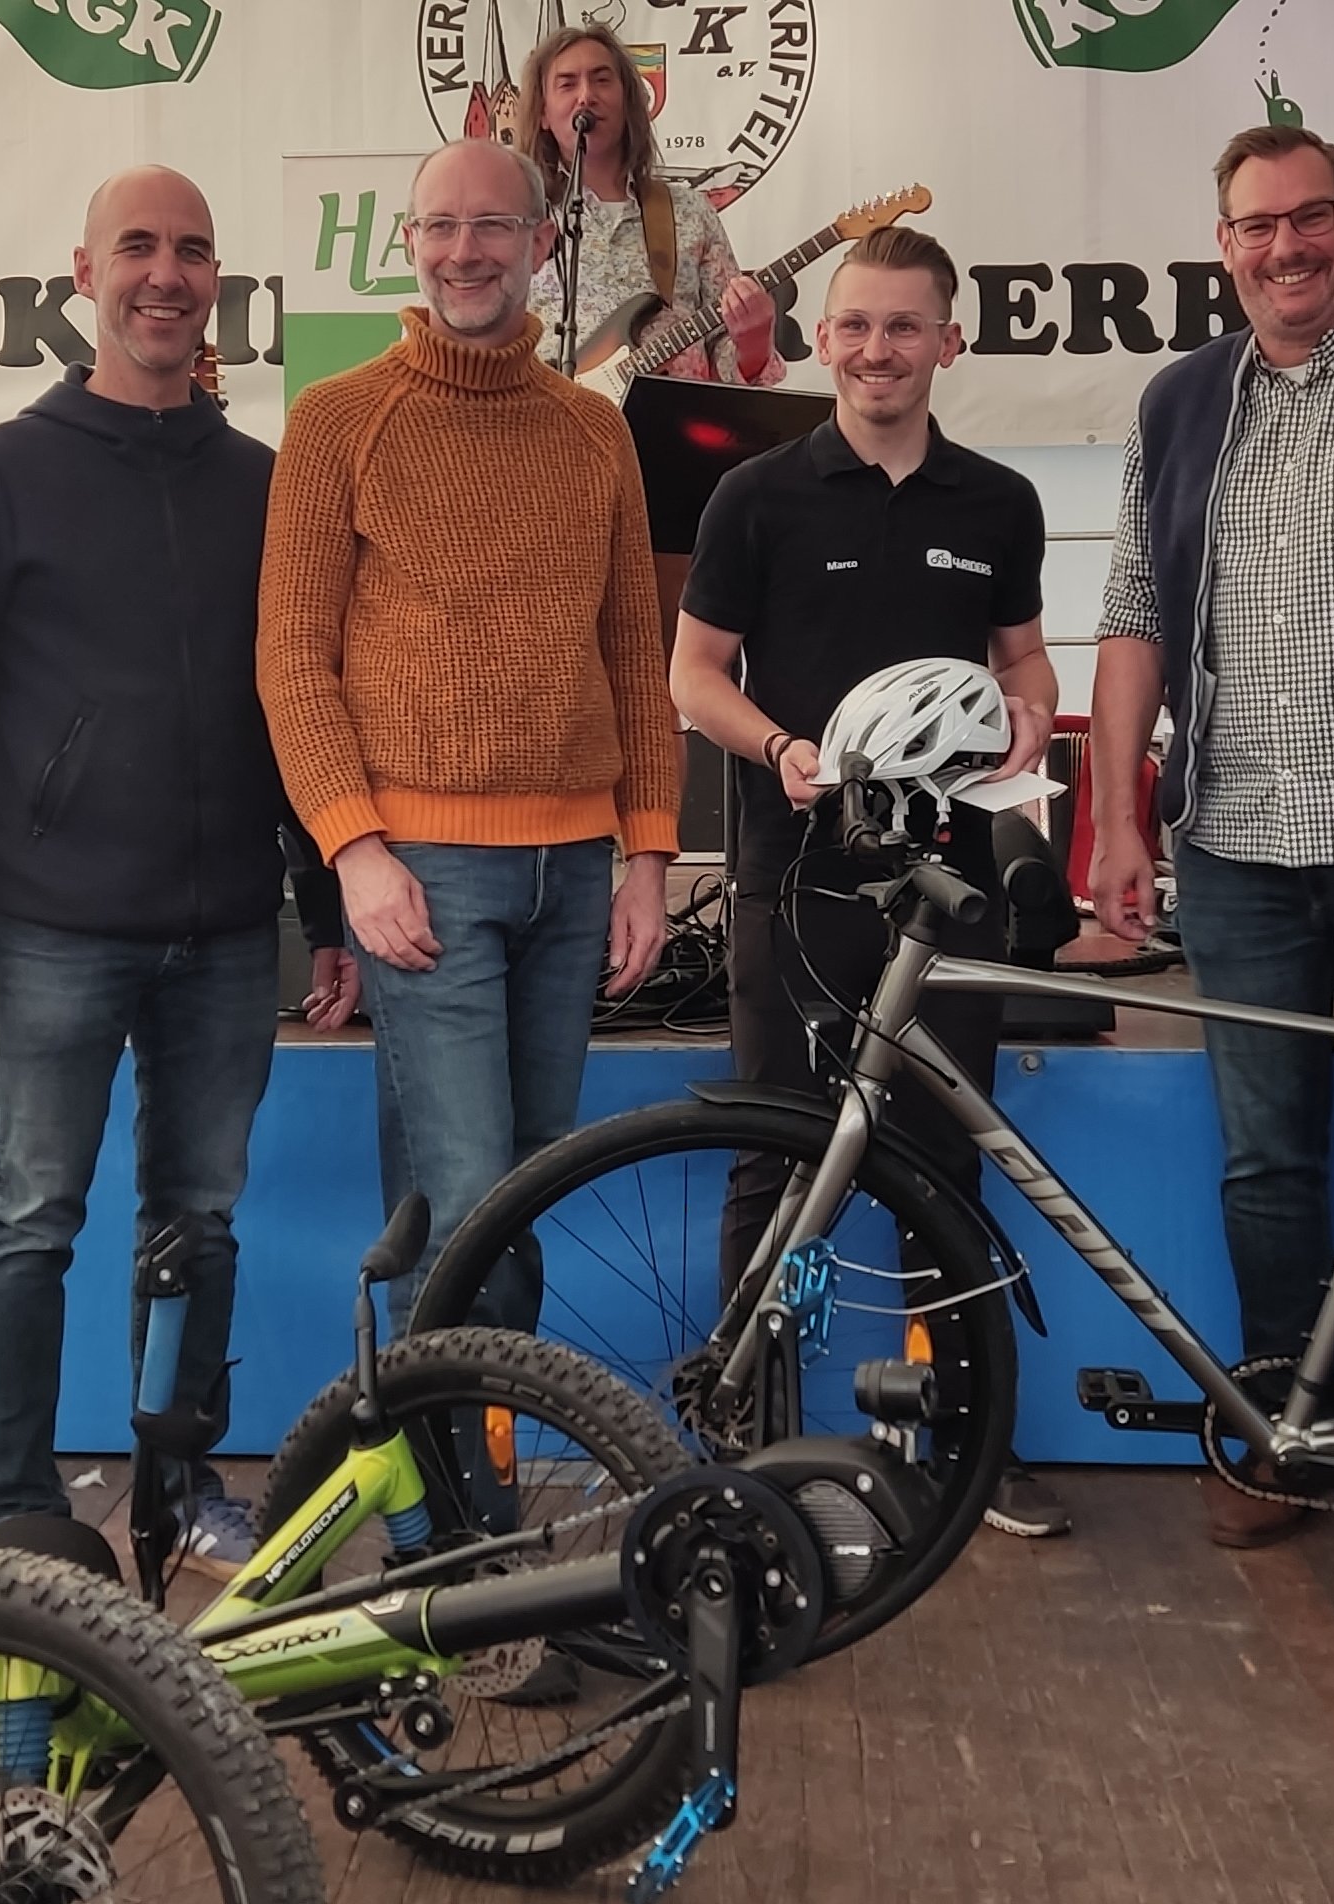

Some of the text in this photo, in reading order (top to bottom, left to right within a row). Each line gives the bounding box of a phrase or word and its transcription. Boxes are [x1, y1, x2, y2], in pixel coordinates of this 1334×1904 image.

[33, 0, 192, 72] GK
[727, 0, 808, 162] KRIFTEL
[665, 136, 706, 149] 1978
[960, 261, 1250, 356] ERB
[826, 560, 859, 571] Marco
[909, 680, 939, 702] ALPINA
[200, 1624, 341, 1663] Scorpion
[402, 1809, 497, 1852] SAM
